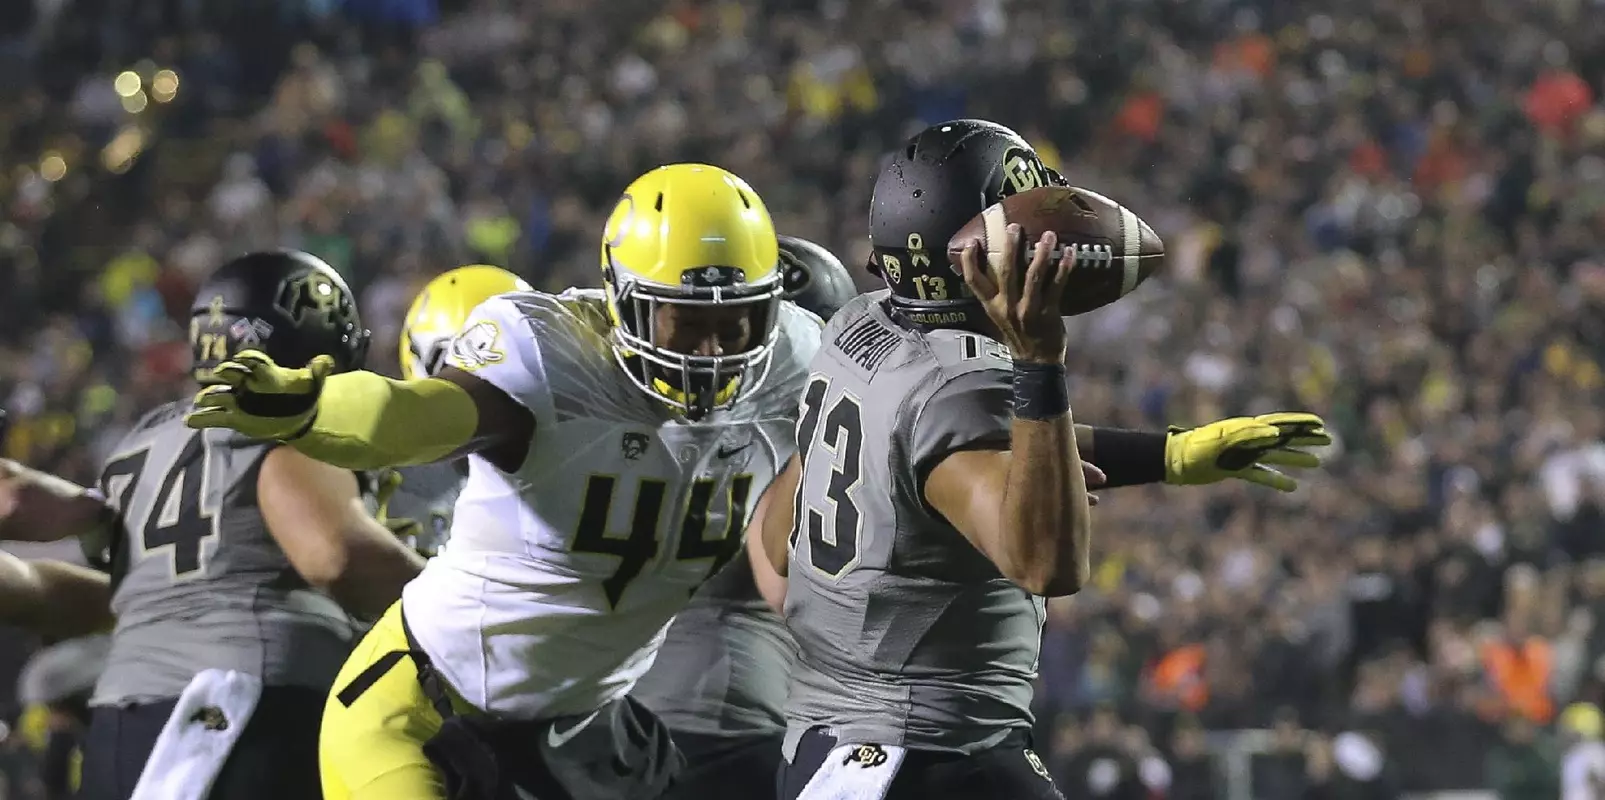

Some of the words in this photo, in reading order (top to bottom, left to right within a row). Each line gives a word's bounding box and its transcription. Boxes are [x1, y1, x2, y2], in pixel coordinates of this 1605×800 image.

[909, 312, 966, 324] COLORADO
[912, 274, 947, 300] 13
[100, 428, 222, 581] 74
[568, 471, 754, 612] 44
[788, 372, 864, 582] 13
